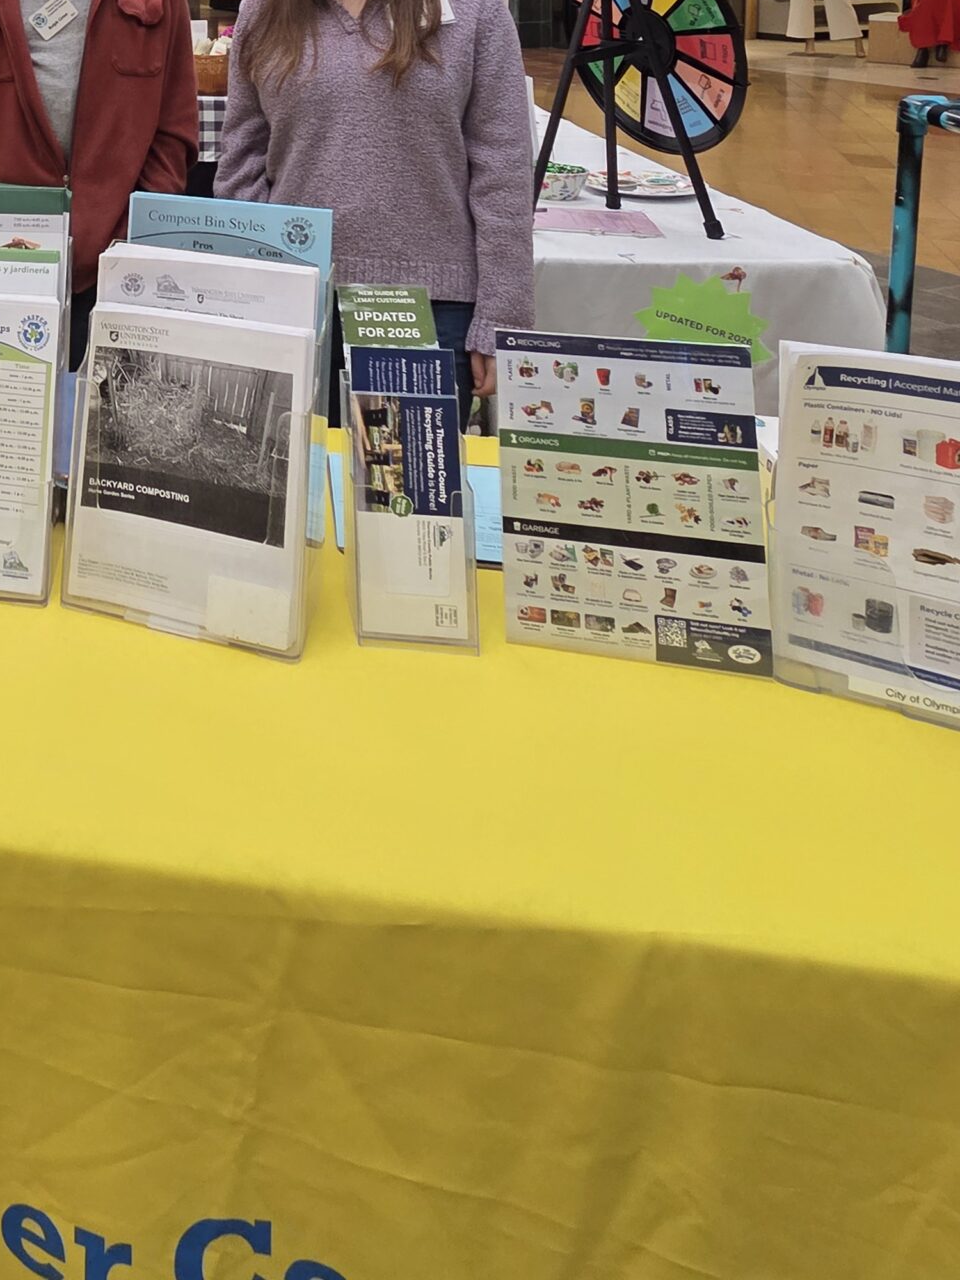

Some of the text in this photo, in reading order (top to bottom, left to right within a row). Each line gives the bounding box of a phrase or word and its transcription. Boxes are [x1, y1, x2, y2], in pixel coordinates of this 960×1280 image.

[148, 210, 266, 233] Compost Bin Styles
[192, 240, 214, 251] Pros
[257, 247, 283, 259] Cons
[354, 311, 416, 322] UPDATED
[100, 321, 170, 336] WASHINGTON STATE
[358, 327, 421, 338] FOR 2026
[655, 309, 753, 346] UPDATED FOR 2026
[120, 332, 159, 342] UNIVERSITY
[518, 339, 561, 348] RECYCLING
[840, 373, 887, 388] Recycling
[894, 379, 941, 394] Accepted
[827, 404, 865, 414] Containers
[884, 410, 902, 419] Lids!
[424, 407, 434, 449] Recycling
[518, 436, 560, 446] ORGANICS
[435, 407, 447, 504] Your Thurston County
[425, 450, 435, 478] Guide
[798, 461, 819, 470] Paper
[89, 477, 190, 503] BACKYARD COMPOSTING
[121, 492, 135, 500] Series
[429, 487, 438, 511] here!
[522, 524, 559, 534] GARBAGE
[920, 605, 953, 618] Recycle
[885, 687, 907, 702] City
[910, 694, 922, 703] of
